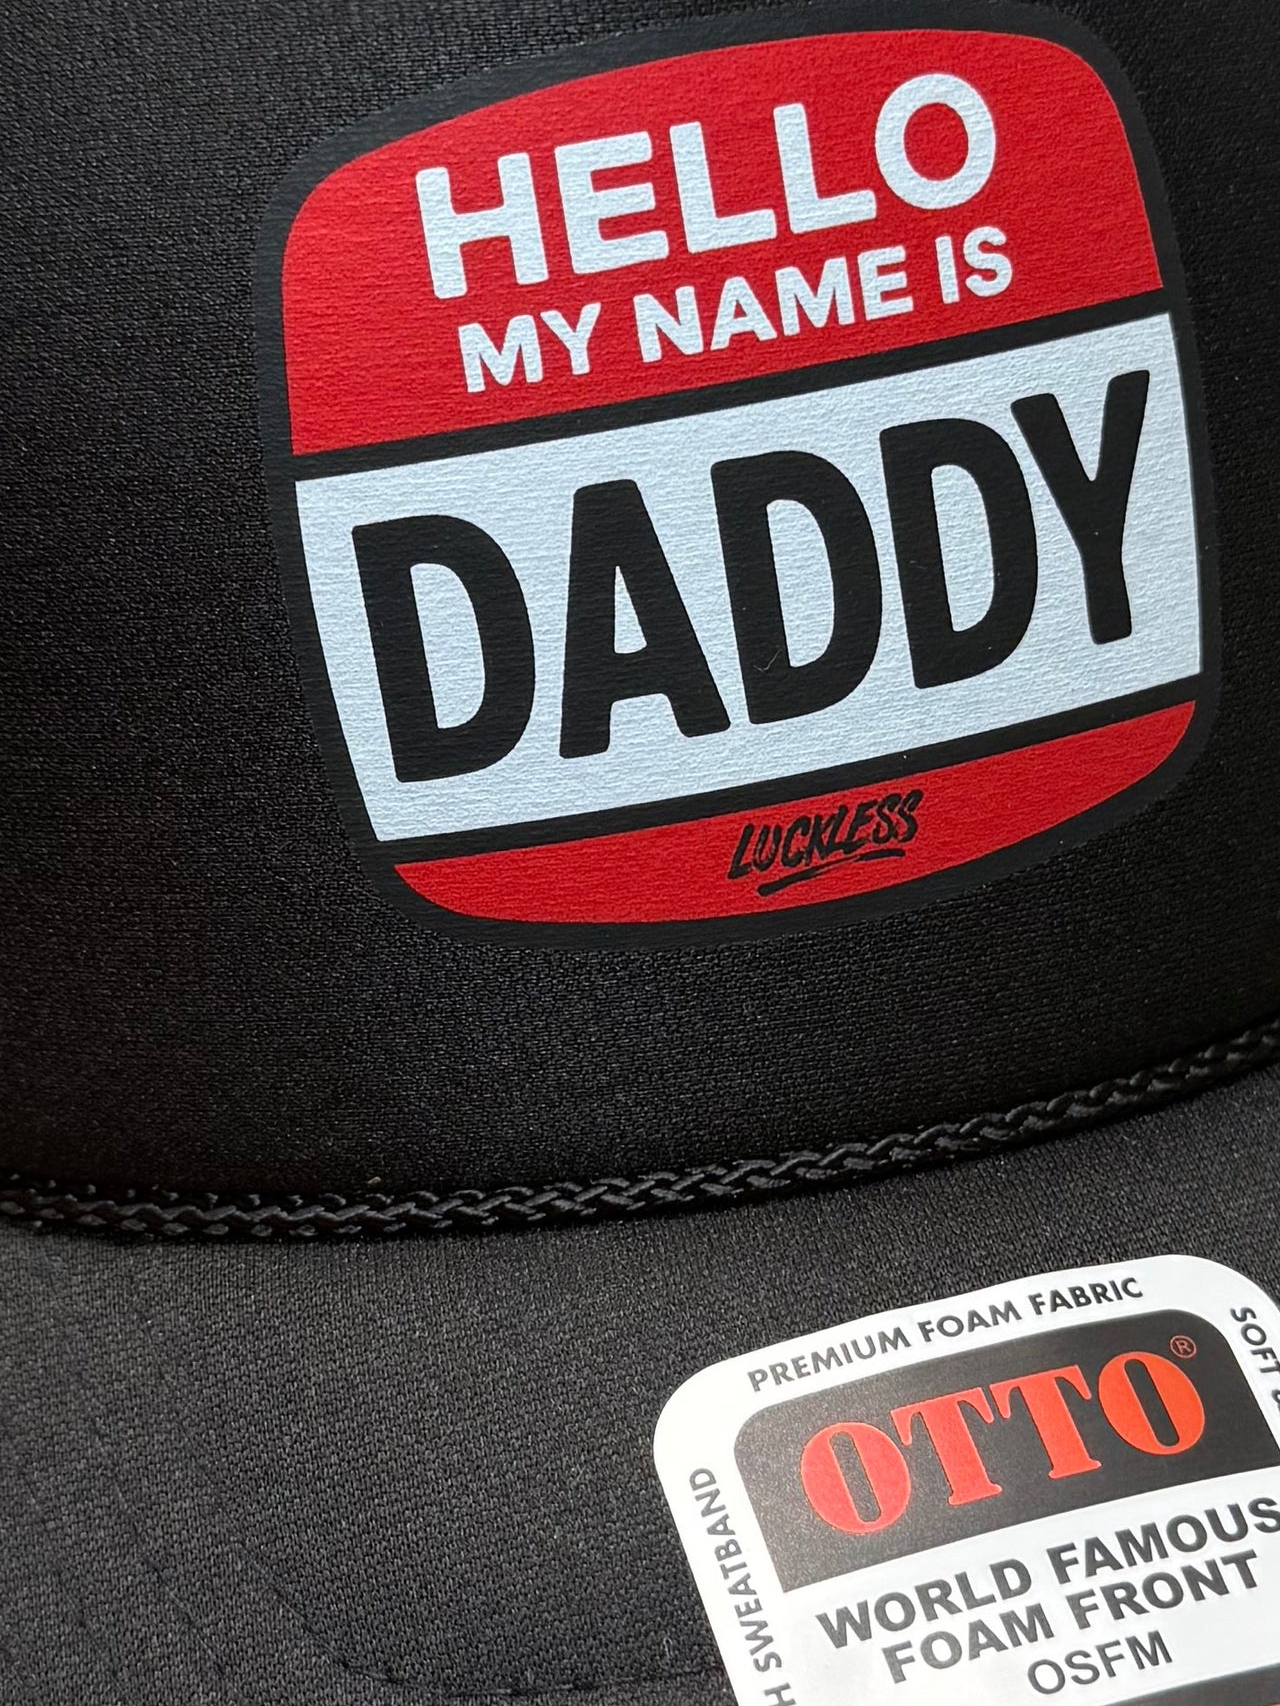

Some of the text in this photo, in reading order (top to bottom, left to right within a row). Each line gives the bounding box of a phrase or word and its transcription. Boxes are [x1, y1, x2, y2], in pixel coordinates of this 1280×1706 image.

[415, 73, 996, 298] HELLO
[459, 226, 1012, 393] MY NAME IS
[351, 370, 1150, 783] DADDY
[728, 789, 923, 879] LUCKLESS
[747, 1278, 1143, 1393] PREMIUM FOAM FABRIC
[690, 1467, 782, 1671] SWEATBAND
[816, 1559, 1031, 1649] WORLD
[881, 1553, 1259, 1683] FOAM FRONT
[1027, 1631, 1173, 1695] OSFM
